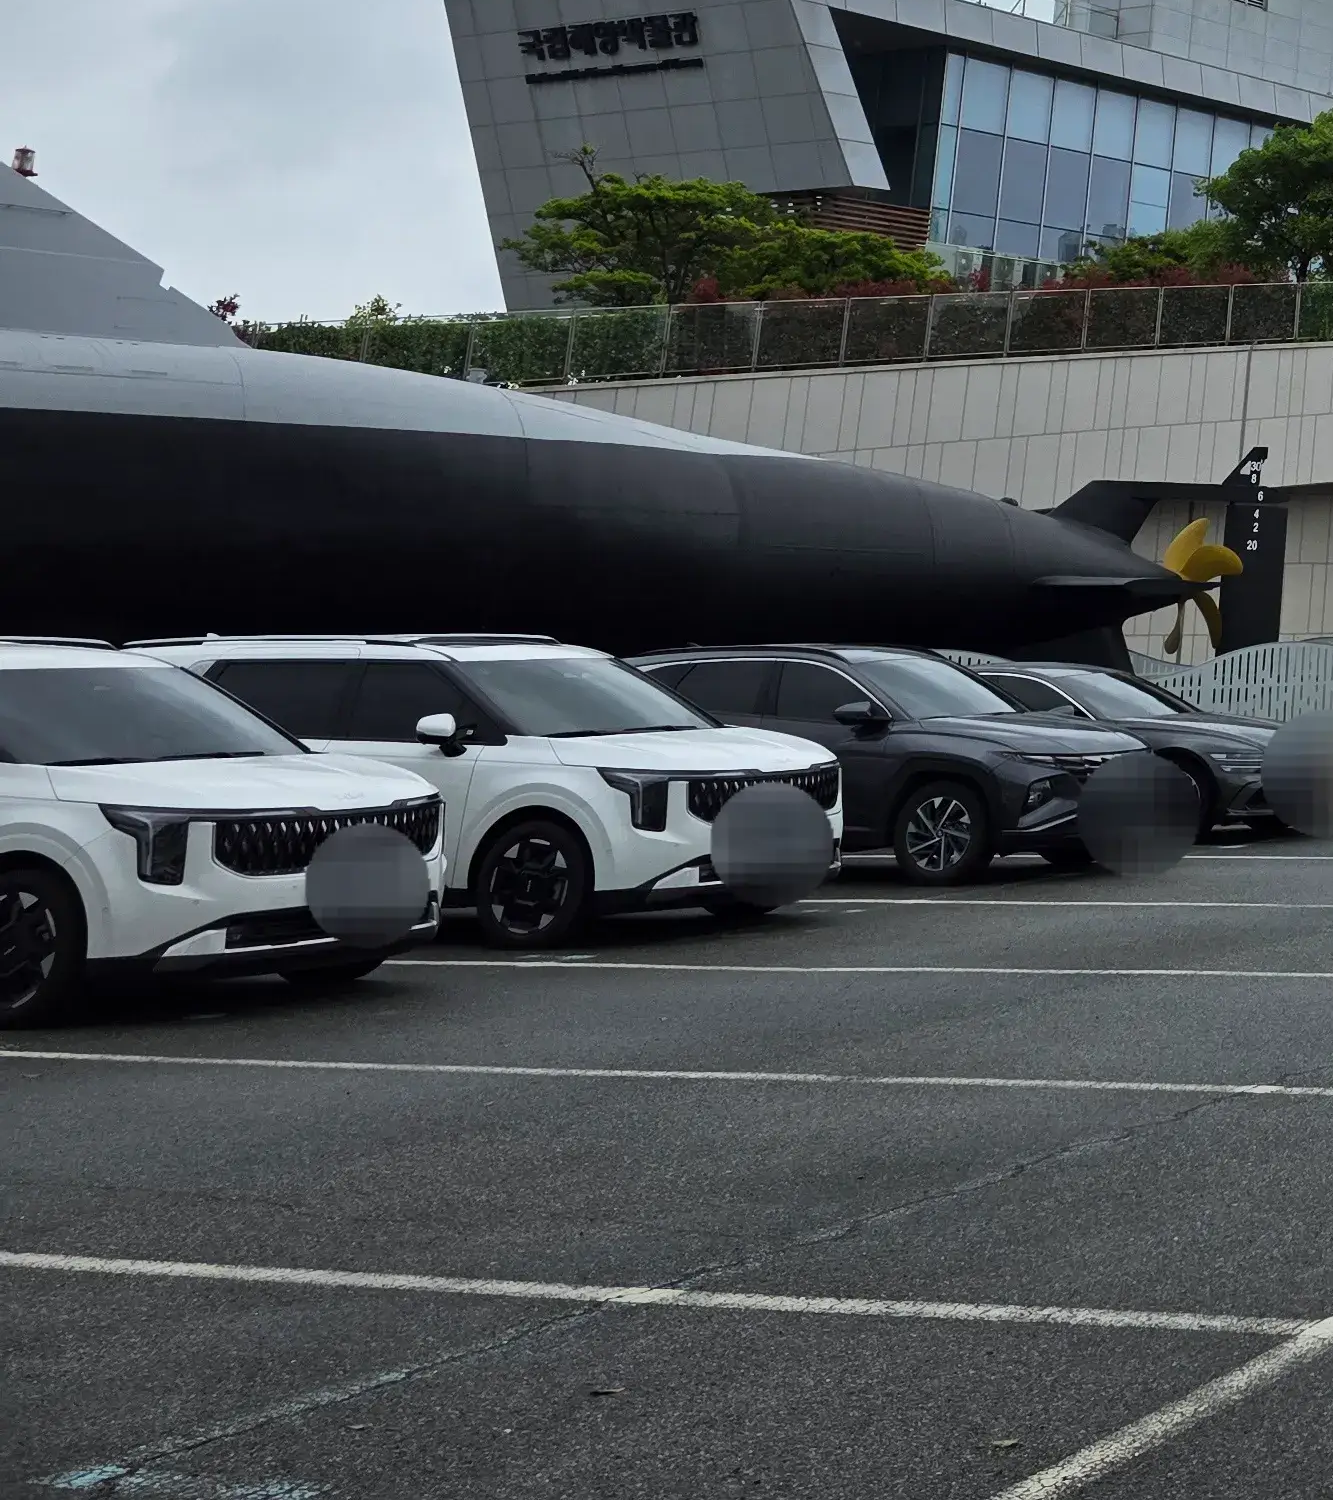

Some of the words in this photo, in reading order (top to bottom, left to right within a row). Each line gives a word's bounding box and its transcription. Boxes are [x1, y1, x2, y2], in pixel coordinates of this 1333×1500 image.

[1250, 473, 1257, 484] 8
[1257, 490, 1264, 501] 6
[1253, 508, 1260, 519] 4
[1252, 522, 1259, 533] 2
[1246, 539, 1258, 551] 20
